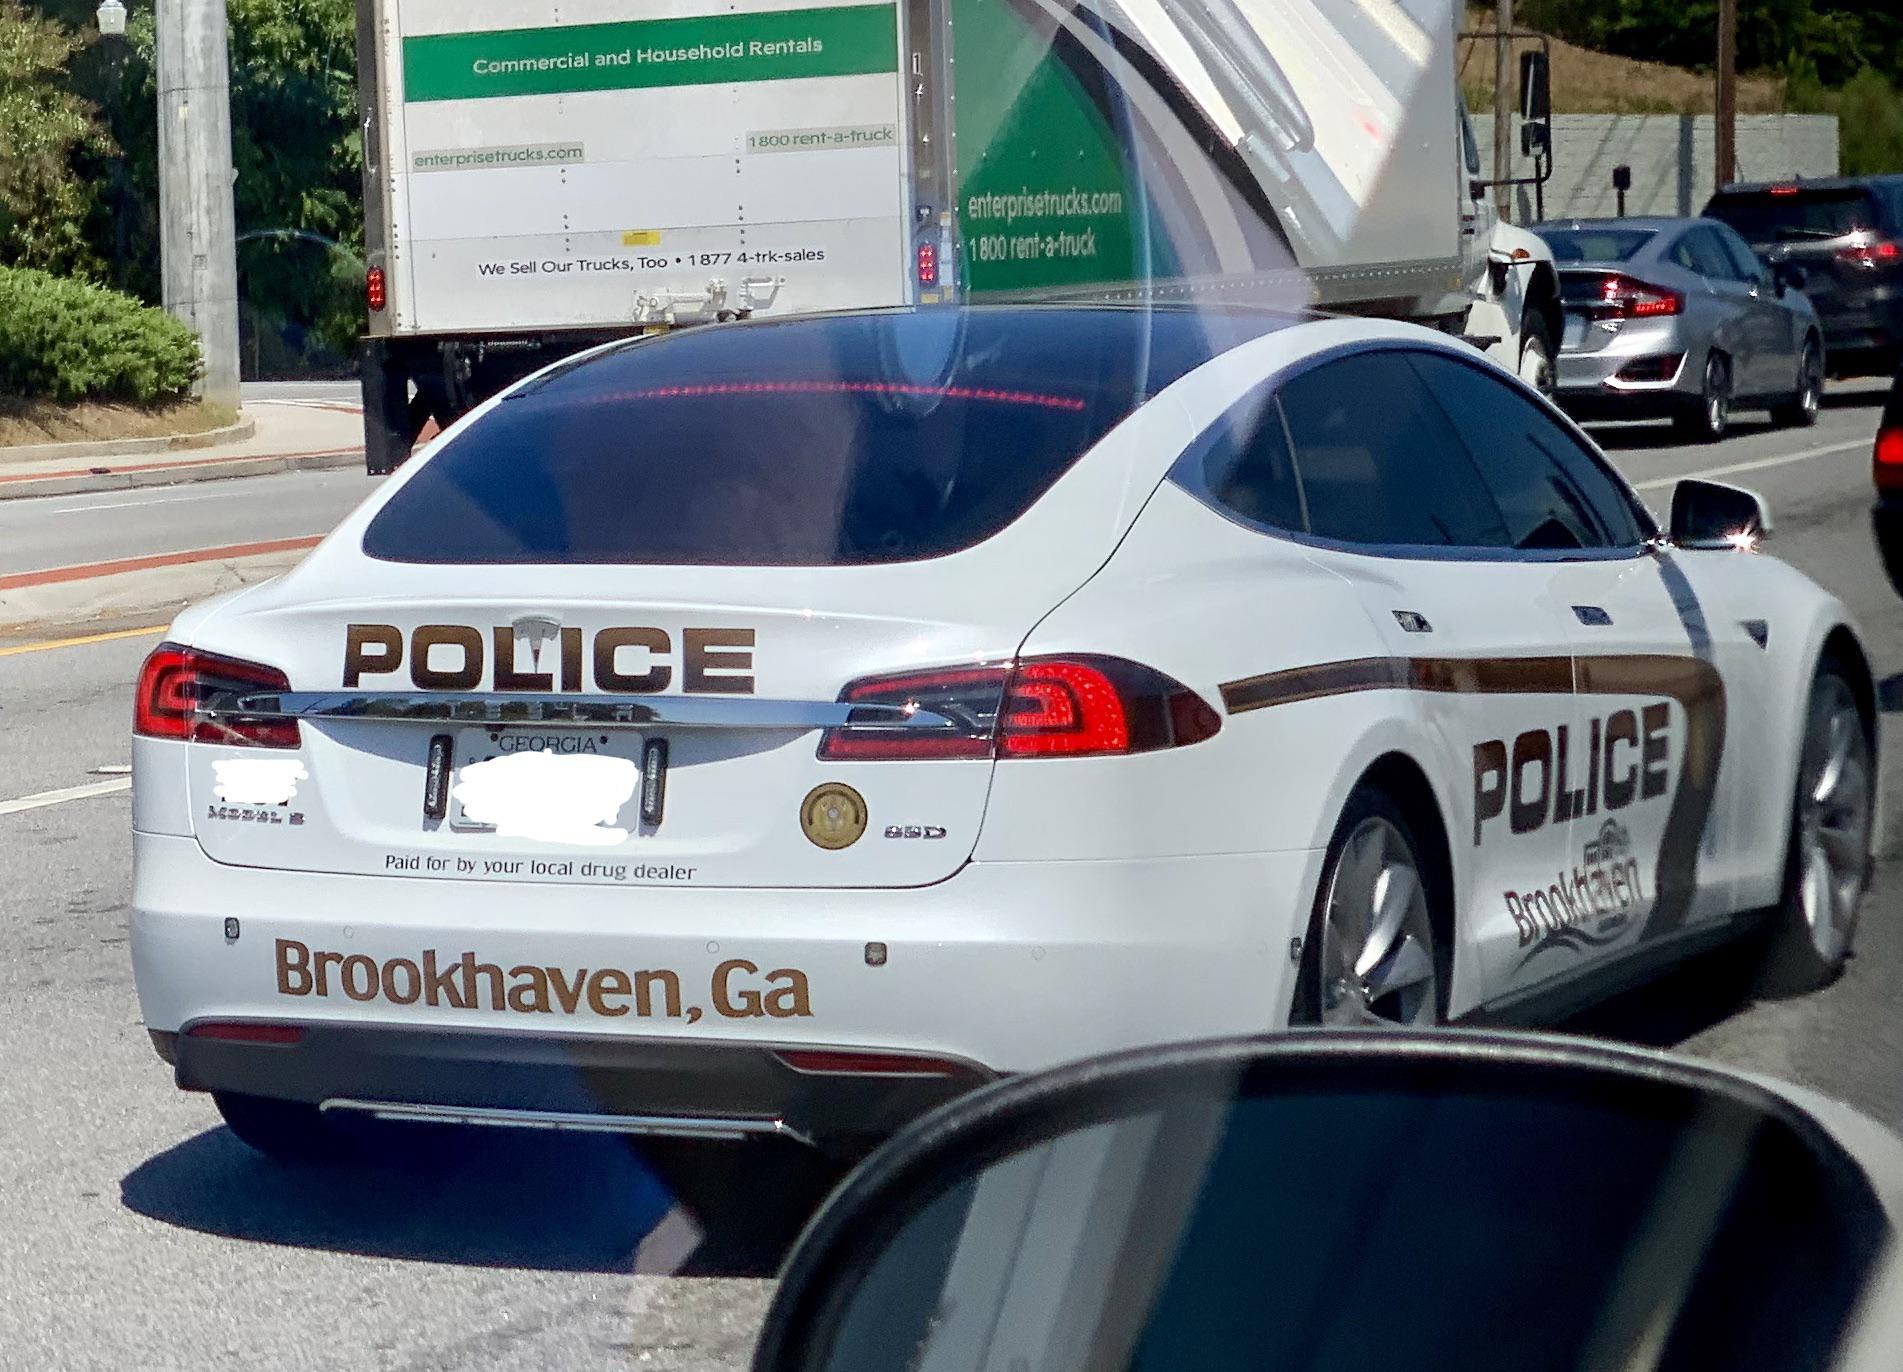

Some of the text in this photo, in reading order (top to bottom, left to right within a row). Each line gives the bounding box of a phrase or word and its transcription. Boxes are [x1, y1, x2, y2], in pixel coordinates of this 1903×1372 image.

[473, 37, 823, 74] Commercial and Household Rentals
[793, 126, 893, 145] rent-a-truck
[414, 147, 583, 169] enterprisetrucks.com
[968, 186, 1122, 224] enterprisetrucks.com
[1010, 227, 1097, 259] rent-a-truck
[478, 263, 506, 276] We
[510, 260, 537, 275] Sell
[541, 260, 573, 273] Our
[577, 257, 635, 272] Trucks,
[637, 256, 668, 270] Too
[736, 248, 825, 263] 4-trk-sales
[342, 623, 756, 694] POLICE
[499, 735, 598, 753] GEORGIA
[1472, 701, 1670, 847] POLICE
[385, 855, 698, 881] Paid for by your local drug dealer
[274, 937, 815, 1024] Brookhaven, Ga
